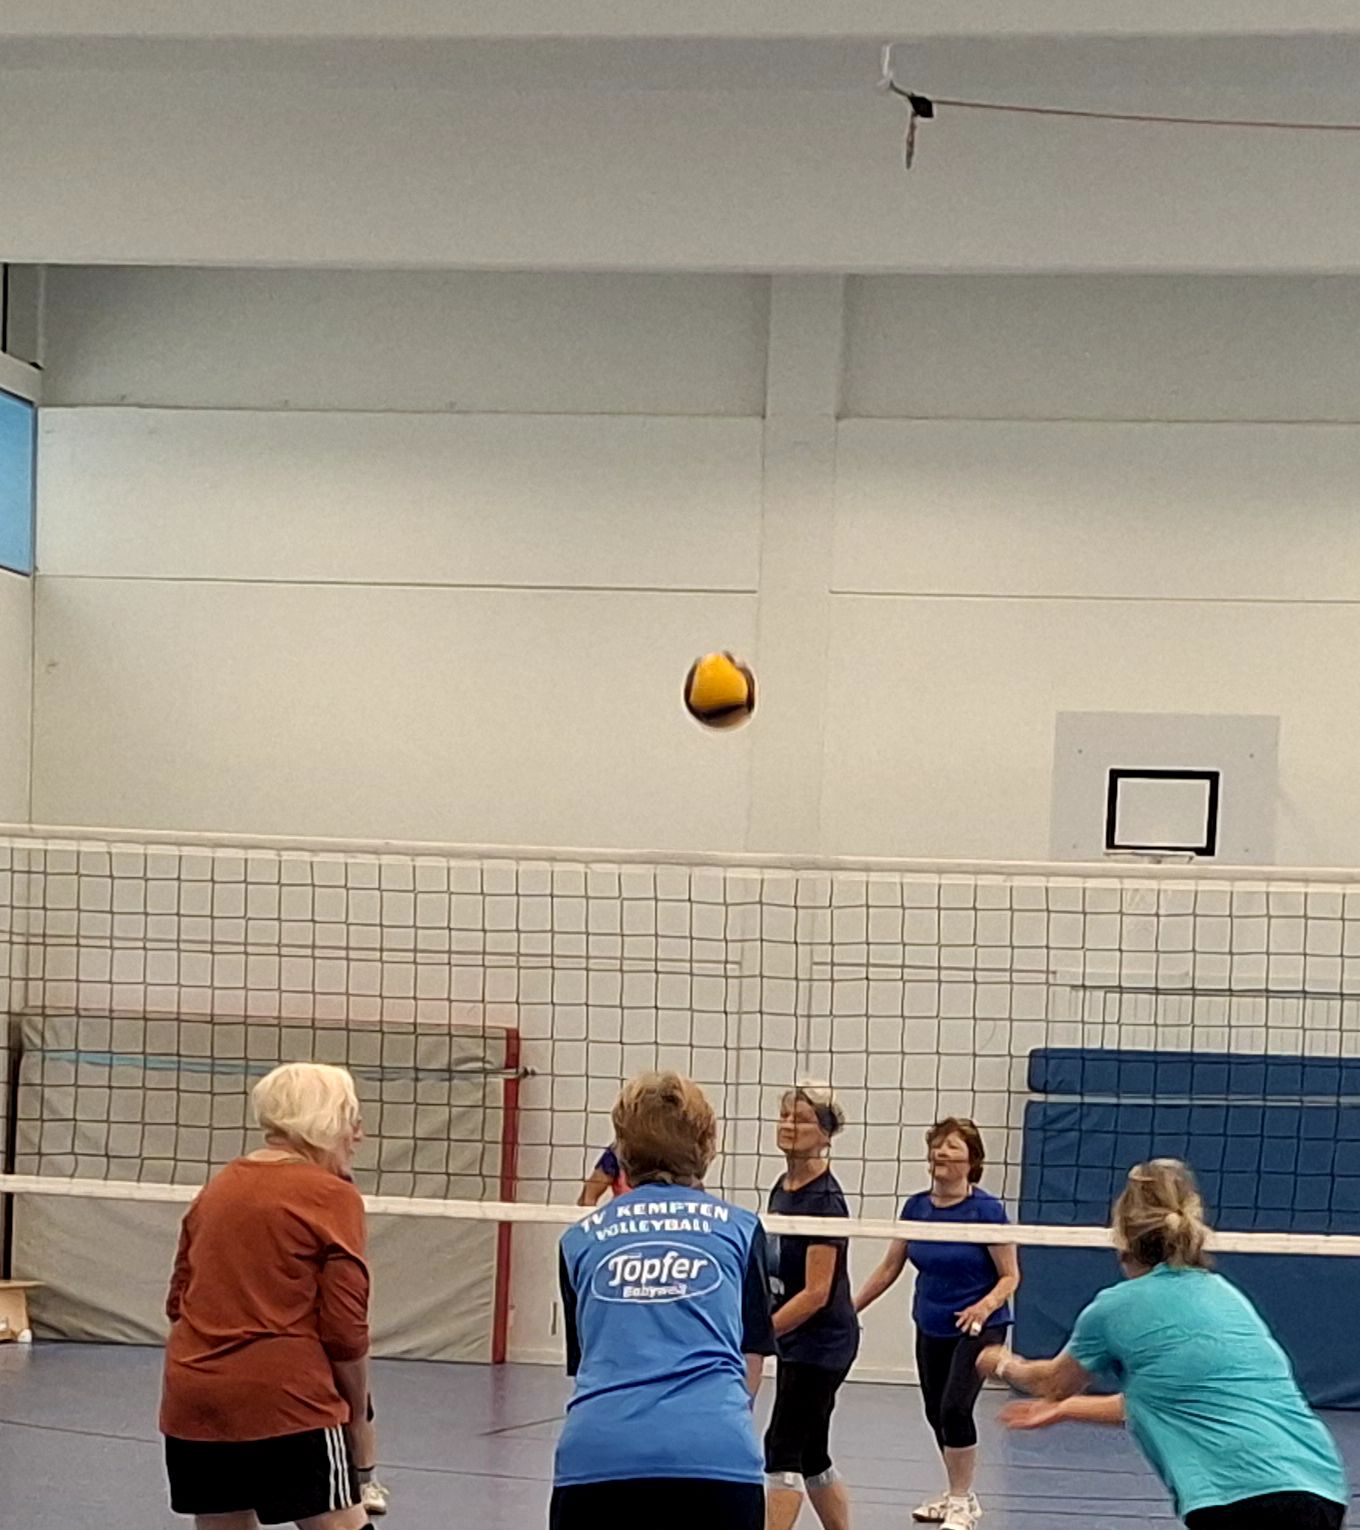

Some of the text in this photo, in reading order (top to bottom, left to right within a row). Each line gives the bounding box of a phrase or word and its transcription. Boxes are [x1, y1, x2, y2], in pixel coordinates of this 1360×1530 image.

[581, 1201, 729, 1234] TV KEMPTEN
[595, 1218, 712, 1241] VOLLEYBALL
